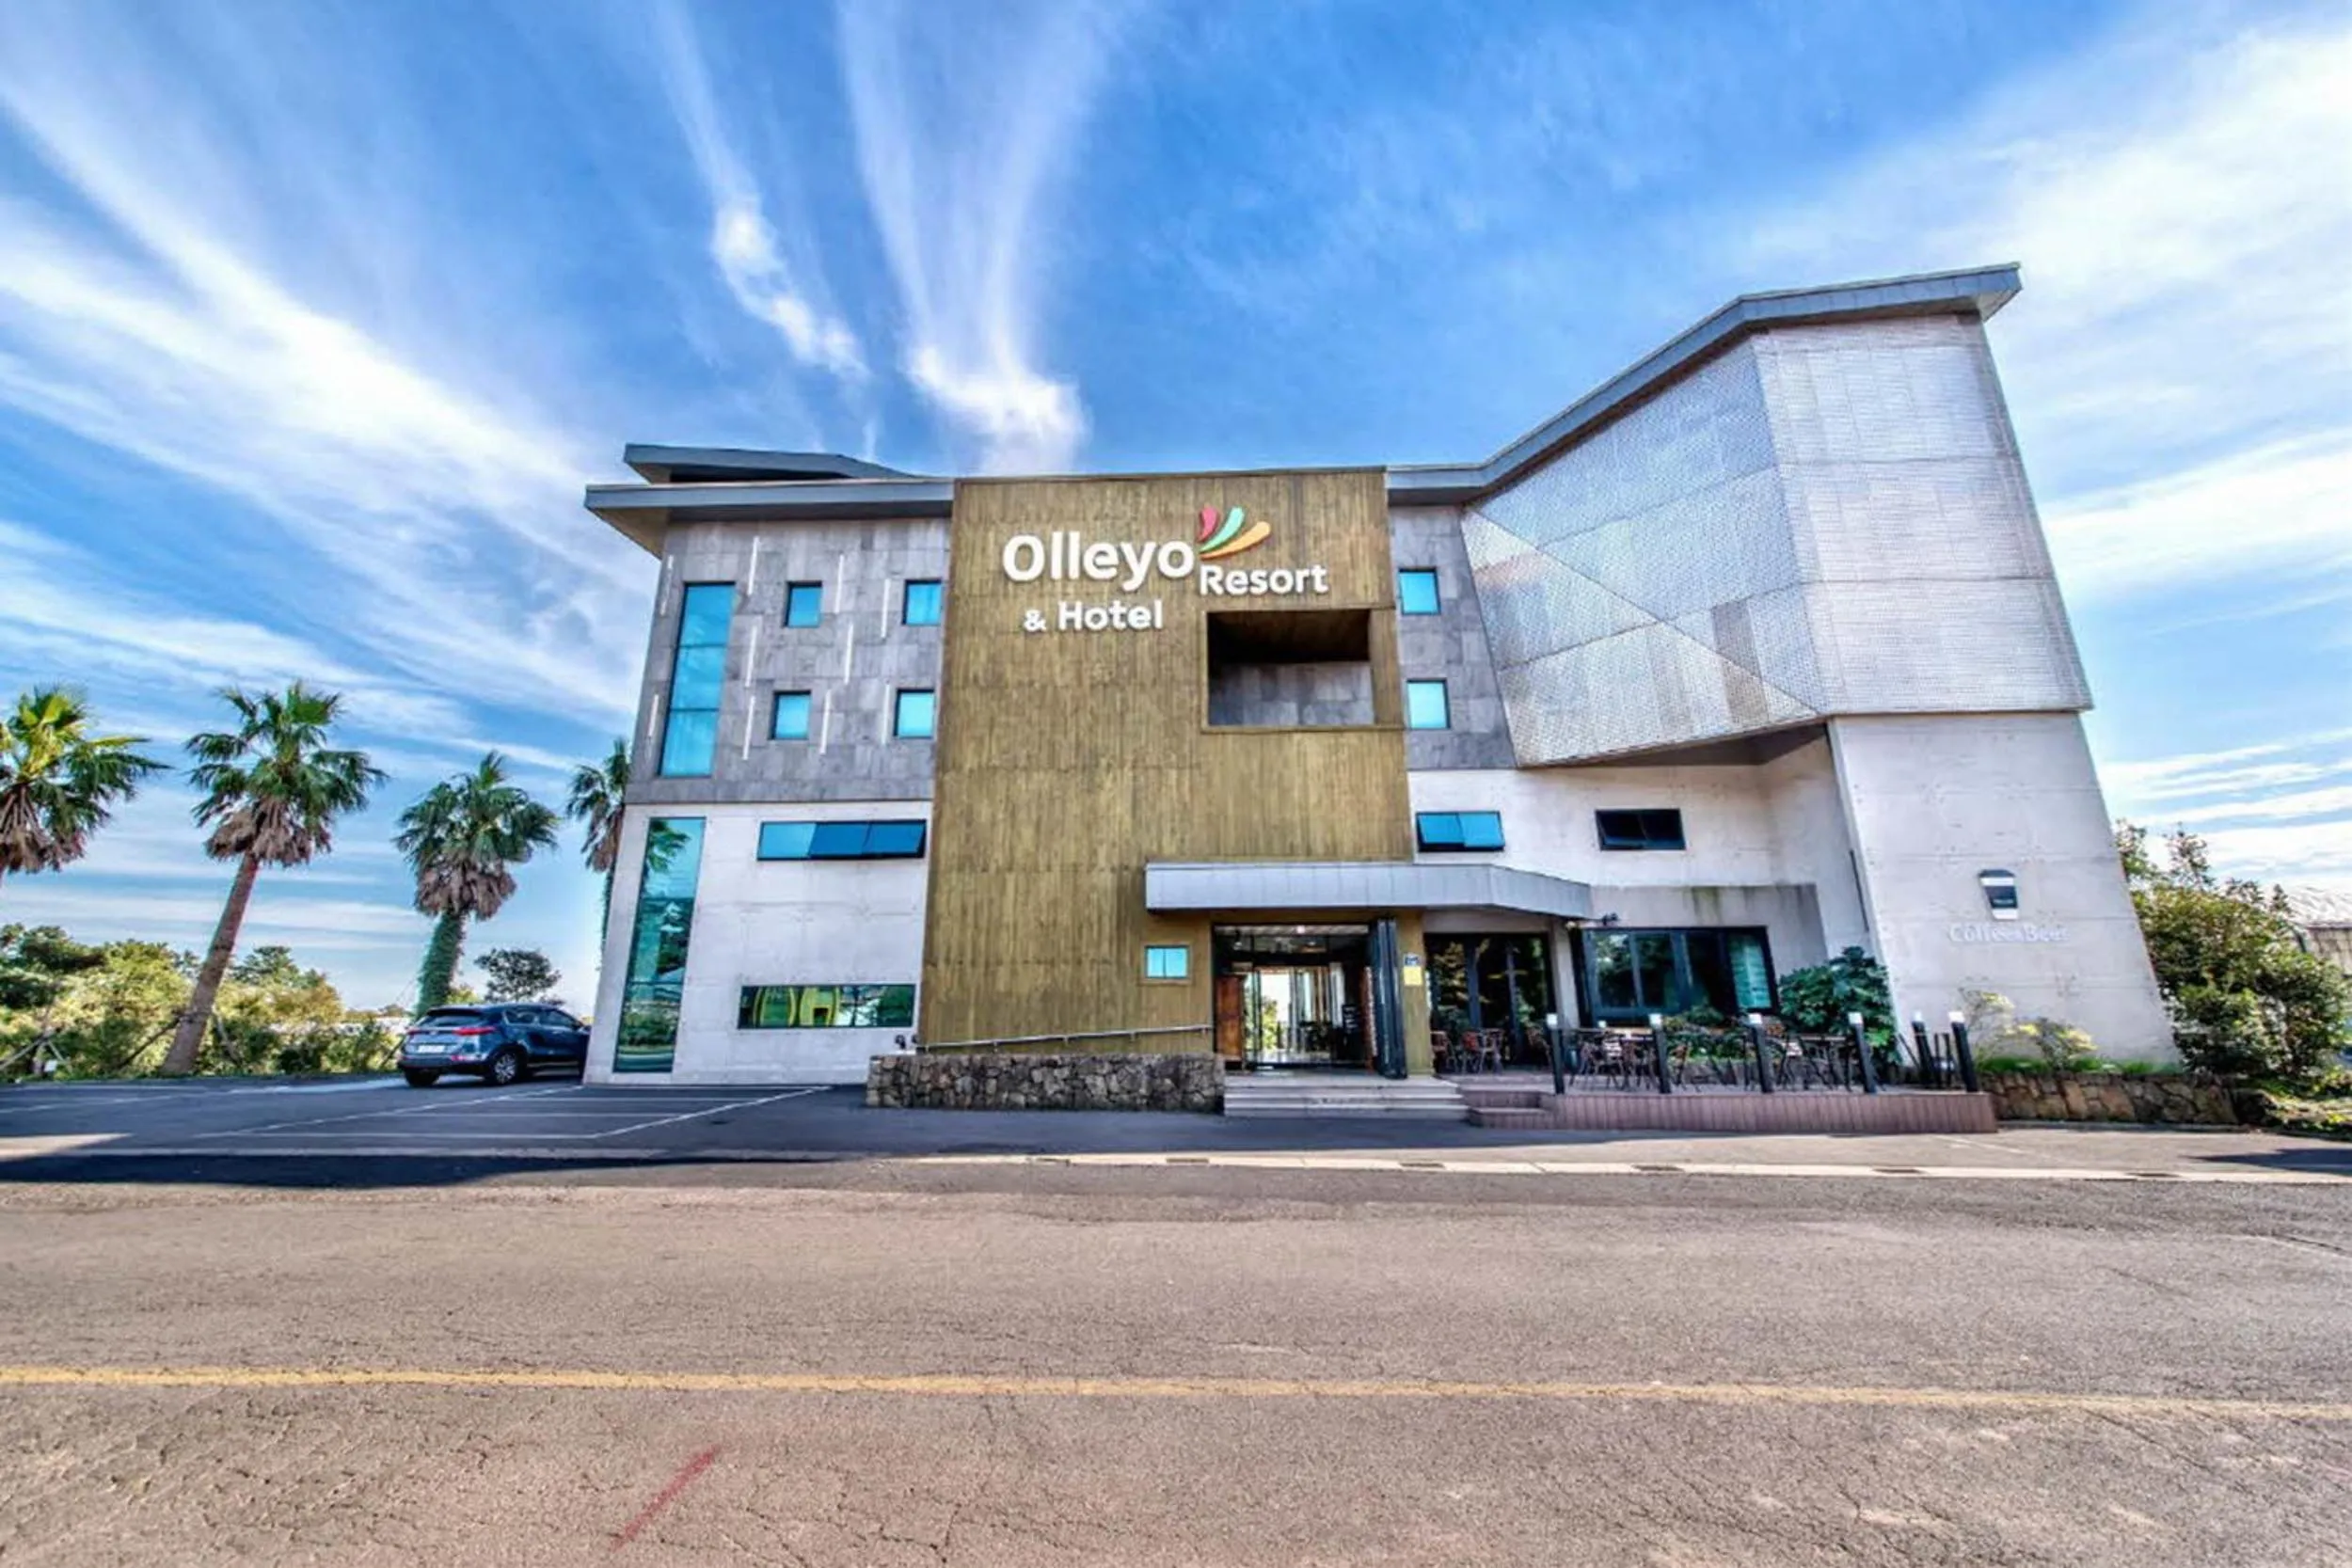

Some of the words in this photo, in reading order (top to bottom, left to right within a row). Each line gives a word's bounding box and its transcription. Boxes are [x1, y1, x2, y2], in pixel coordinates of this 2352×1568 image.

[1003, 531, 1194, 591] Olleyo
[1200, 564, 1328, 595] Resort
[1024, 610, 1046, 631] &
[1057, 599, 1163, 630] Hotel
